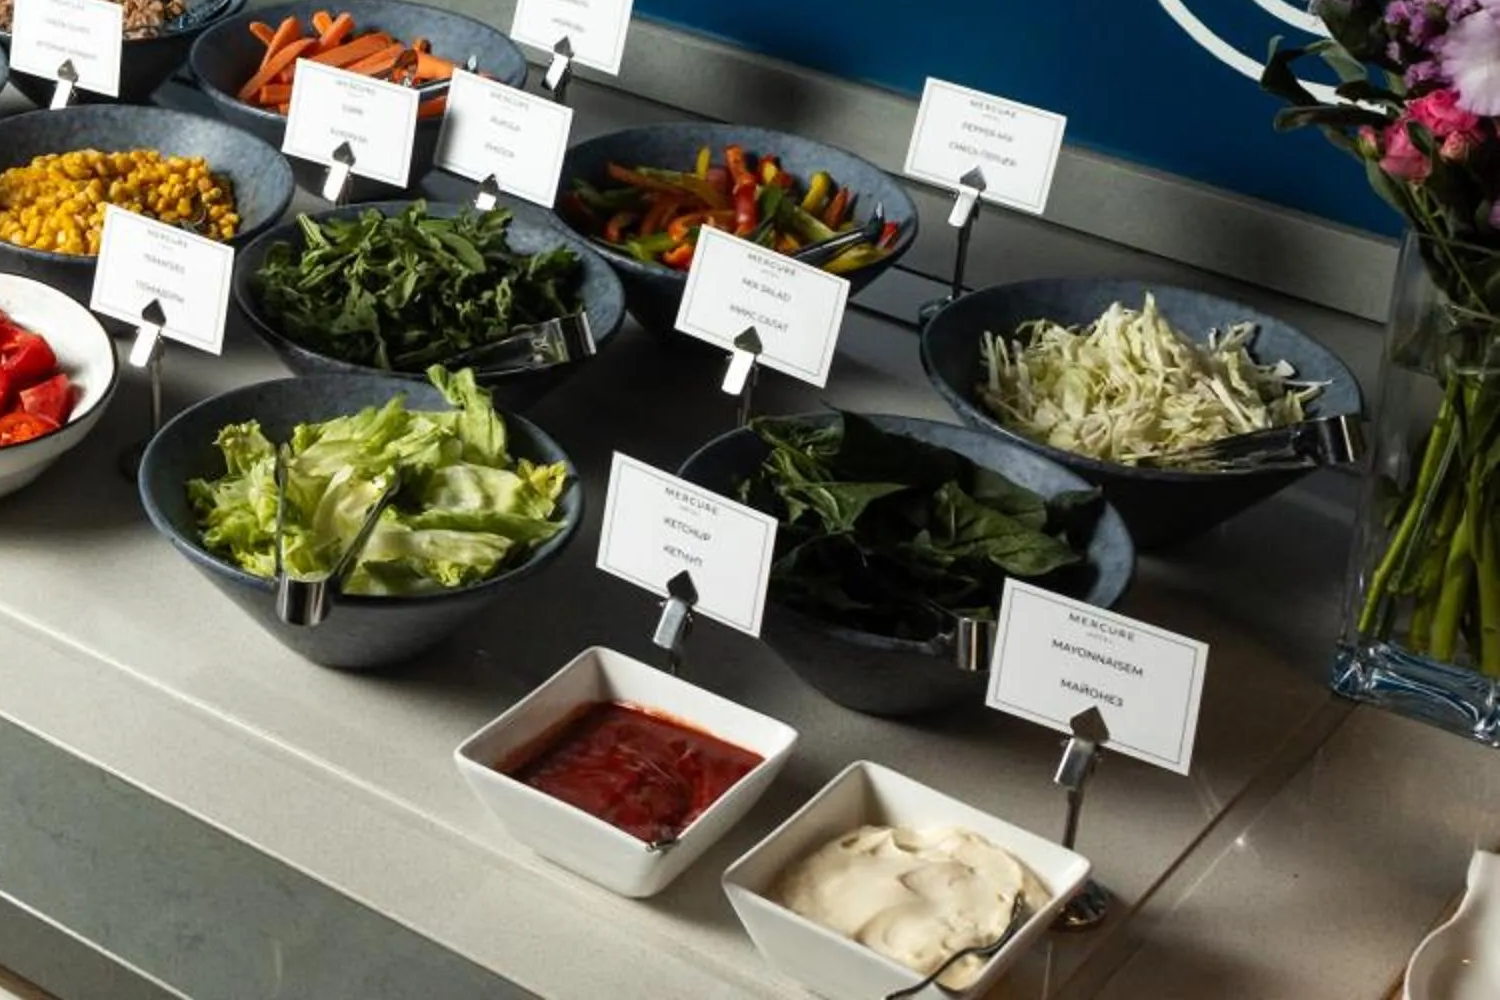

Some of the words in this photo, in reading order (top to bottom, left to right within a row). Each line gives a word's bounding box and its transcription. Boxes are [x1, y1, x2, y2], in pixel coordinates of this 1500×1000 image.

[665, 487, 718, 515] MERCURE
[663, 517, 711, 541] KETCHUP
[1068, 612, 1136, 642] MERCURE
[1051, 638, 1144, 677] MAYONNAISEM
[1060, 679, 1124, 707] МАЙОНЕЗ
